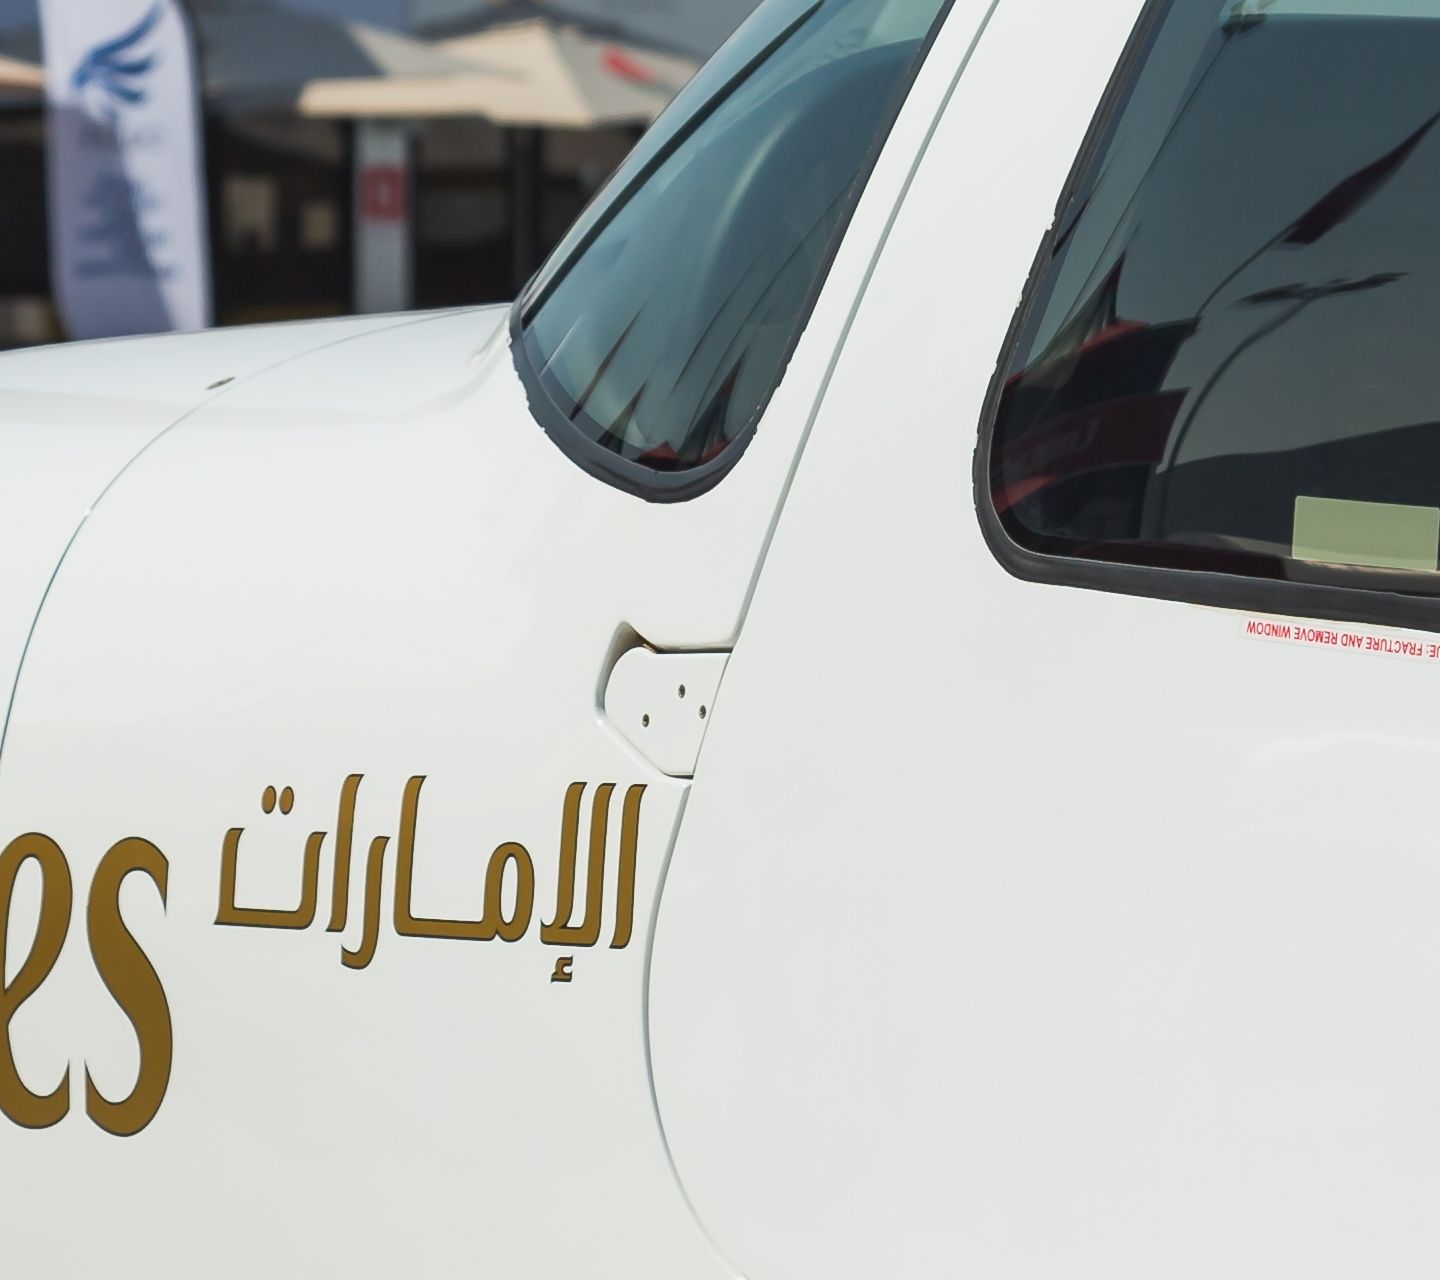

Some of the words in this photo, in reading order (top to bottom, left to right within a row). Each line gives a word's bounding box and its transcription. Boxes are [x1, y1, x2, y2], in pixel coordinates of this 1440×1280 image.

[1246, 621, 1291, 639] WINDOW
[1293, 626, 1338, 645] REMOVE
[1340, 633, 1362, 648] AND
[1365, 635, 1423, 657] FRACTURE
[213, 773, 648, 983] الإمارات
